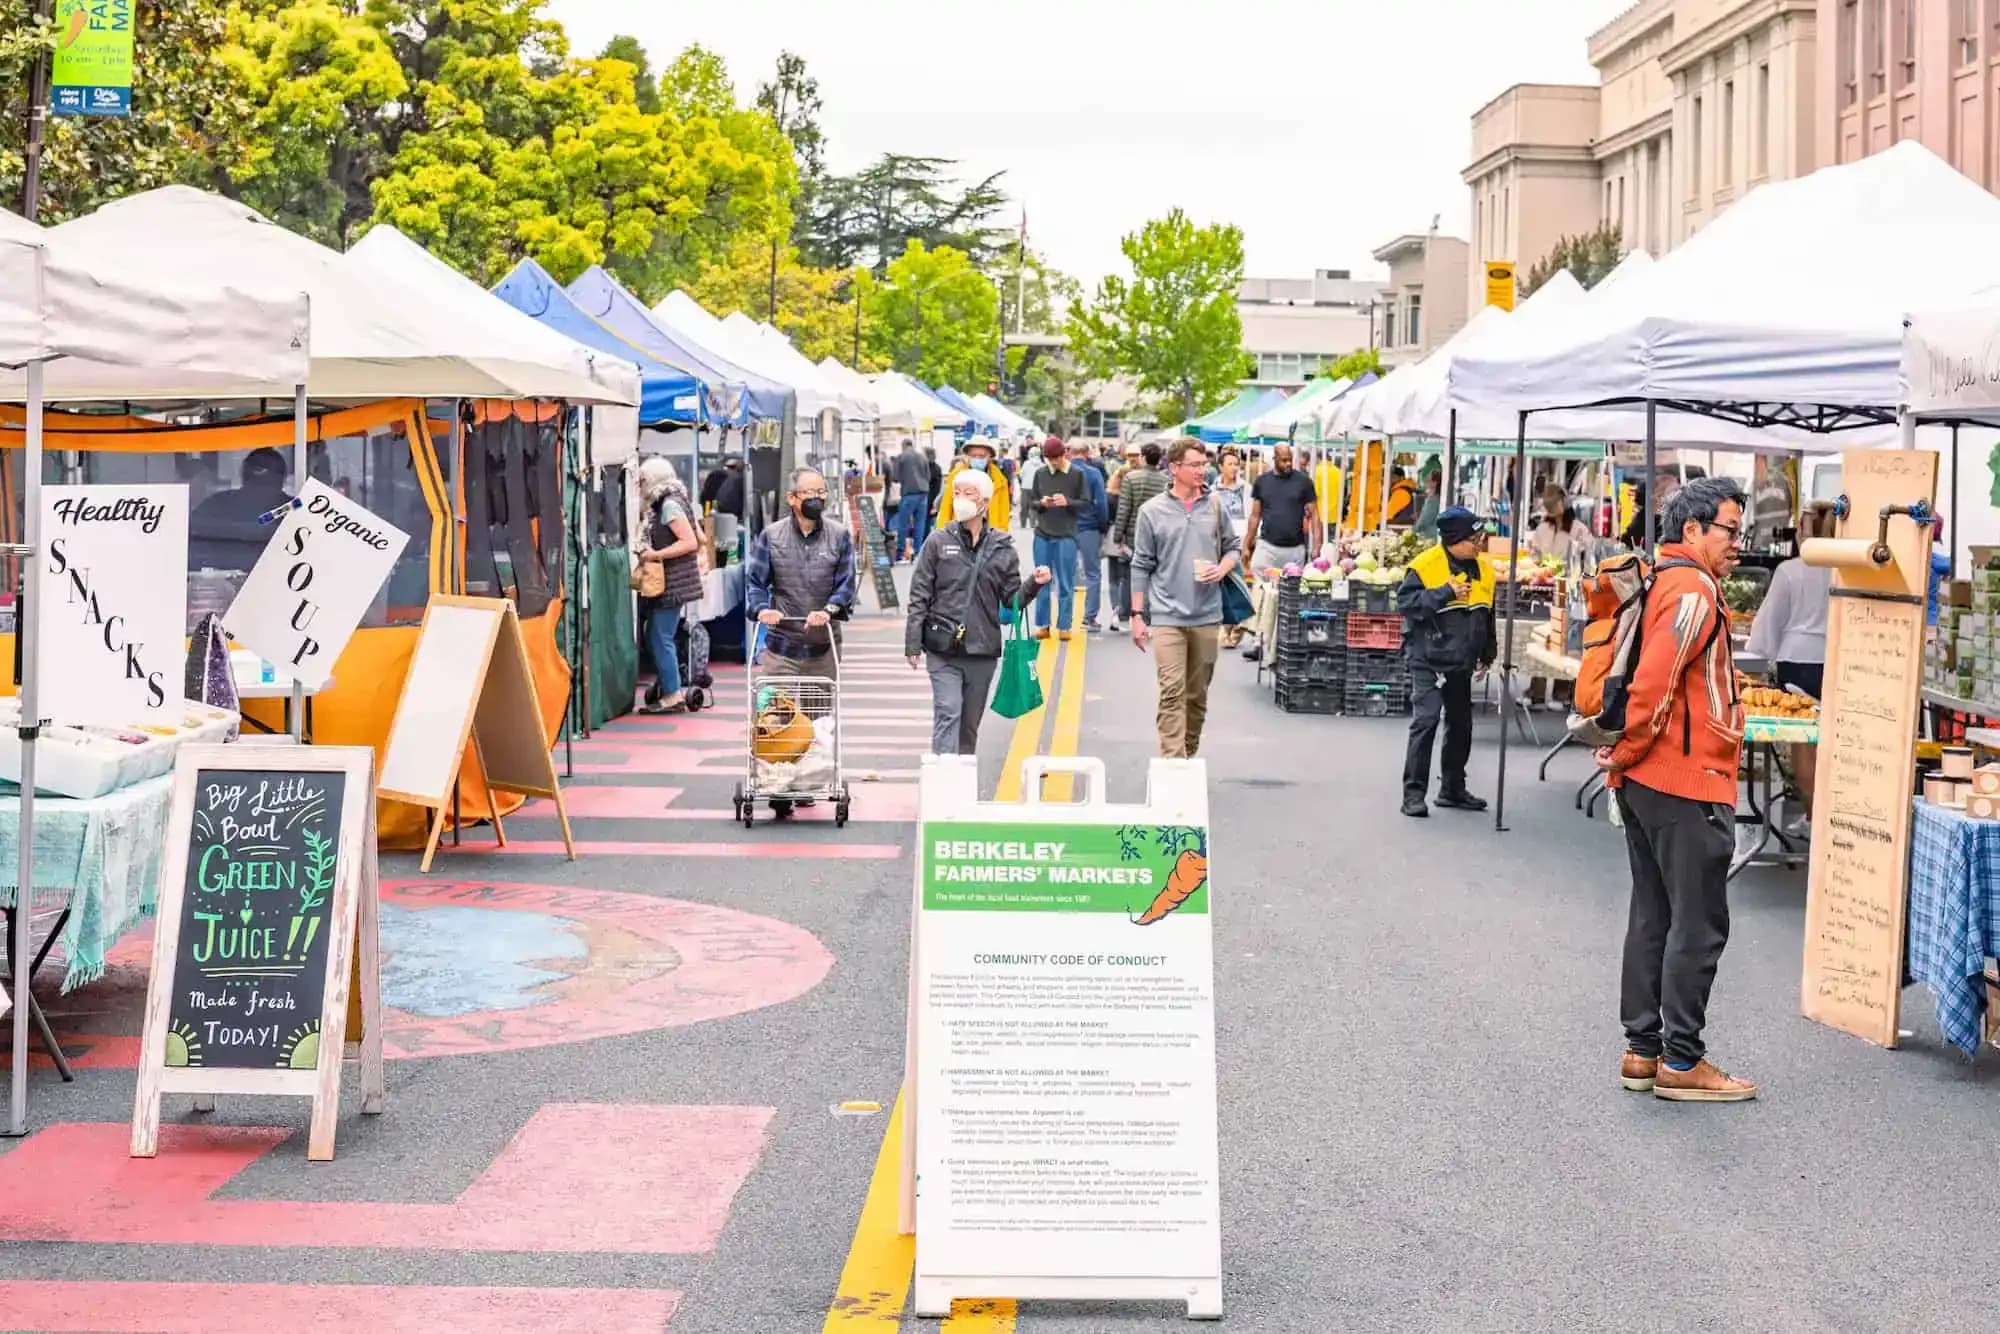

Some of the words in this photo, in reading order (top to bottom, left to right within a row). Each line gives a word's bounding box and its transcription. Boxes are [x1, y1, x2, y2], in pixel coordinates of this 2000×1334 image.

[90, 0, 108, 30] FA
[53, 497, 165, 533] Healthy
[308, 494, 389, 551] Organic
[284, 526, 320, 667] SOUP
[49, 538, 164, 708] SNACKS
[206, 784, 247, 812] Big
[248, 777, 325, 816] Little
[220, 816, 280, 845] Bowl
[934, 840, 1065, 862] BERKELEY
[199, 844, 296, 896] GREEN
[934, 864, 1042, 884] FARMERS'
[1047, 866, 1153, 885] MARKETS
[973, 953, 1048, 966] COMMUNITY
[1050, 954, 1085, 967] CODE
[1087, 954, 1104, 967] OF
[1107, 955, 1169, 967] CONDUCT
[189, 989, 237, 1009] Made
[245, 990, 296, 1016] fresh
[204, 1021, 279, 1048] TODAY!
[968, 1020, 995, 1029] SPEECH
[1005, 1021, 1019, 1029] NOT
[1020, 1021, 1054, 1030] ALLOWED
[1080, 1021, 1109, 1030] MARKET
[1005, 1068, 1019, 1078] NOT
[1020, 1069, 1054, 1078] ALLOWED
[1080, 1069, 1110, 1078] MARKET
